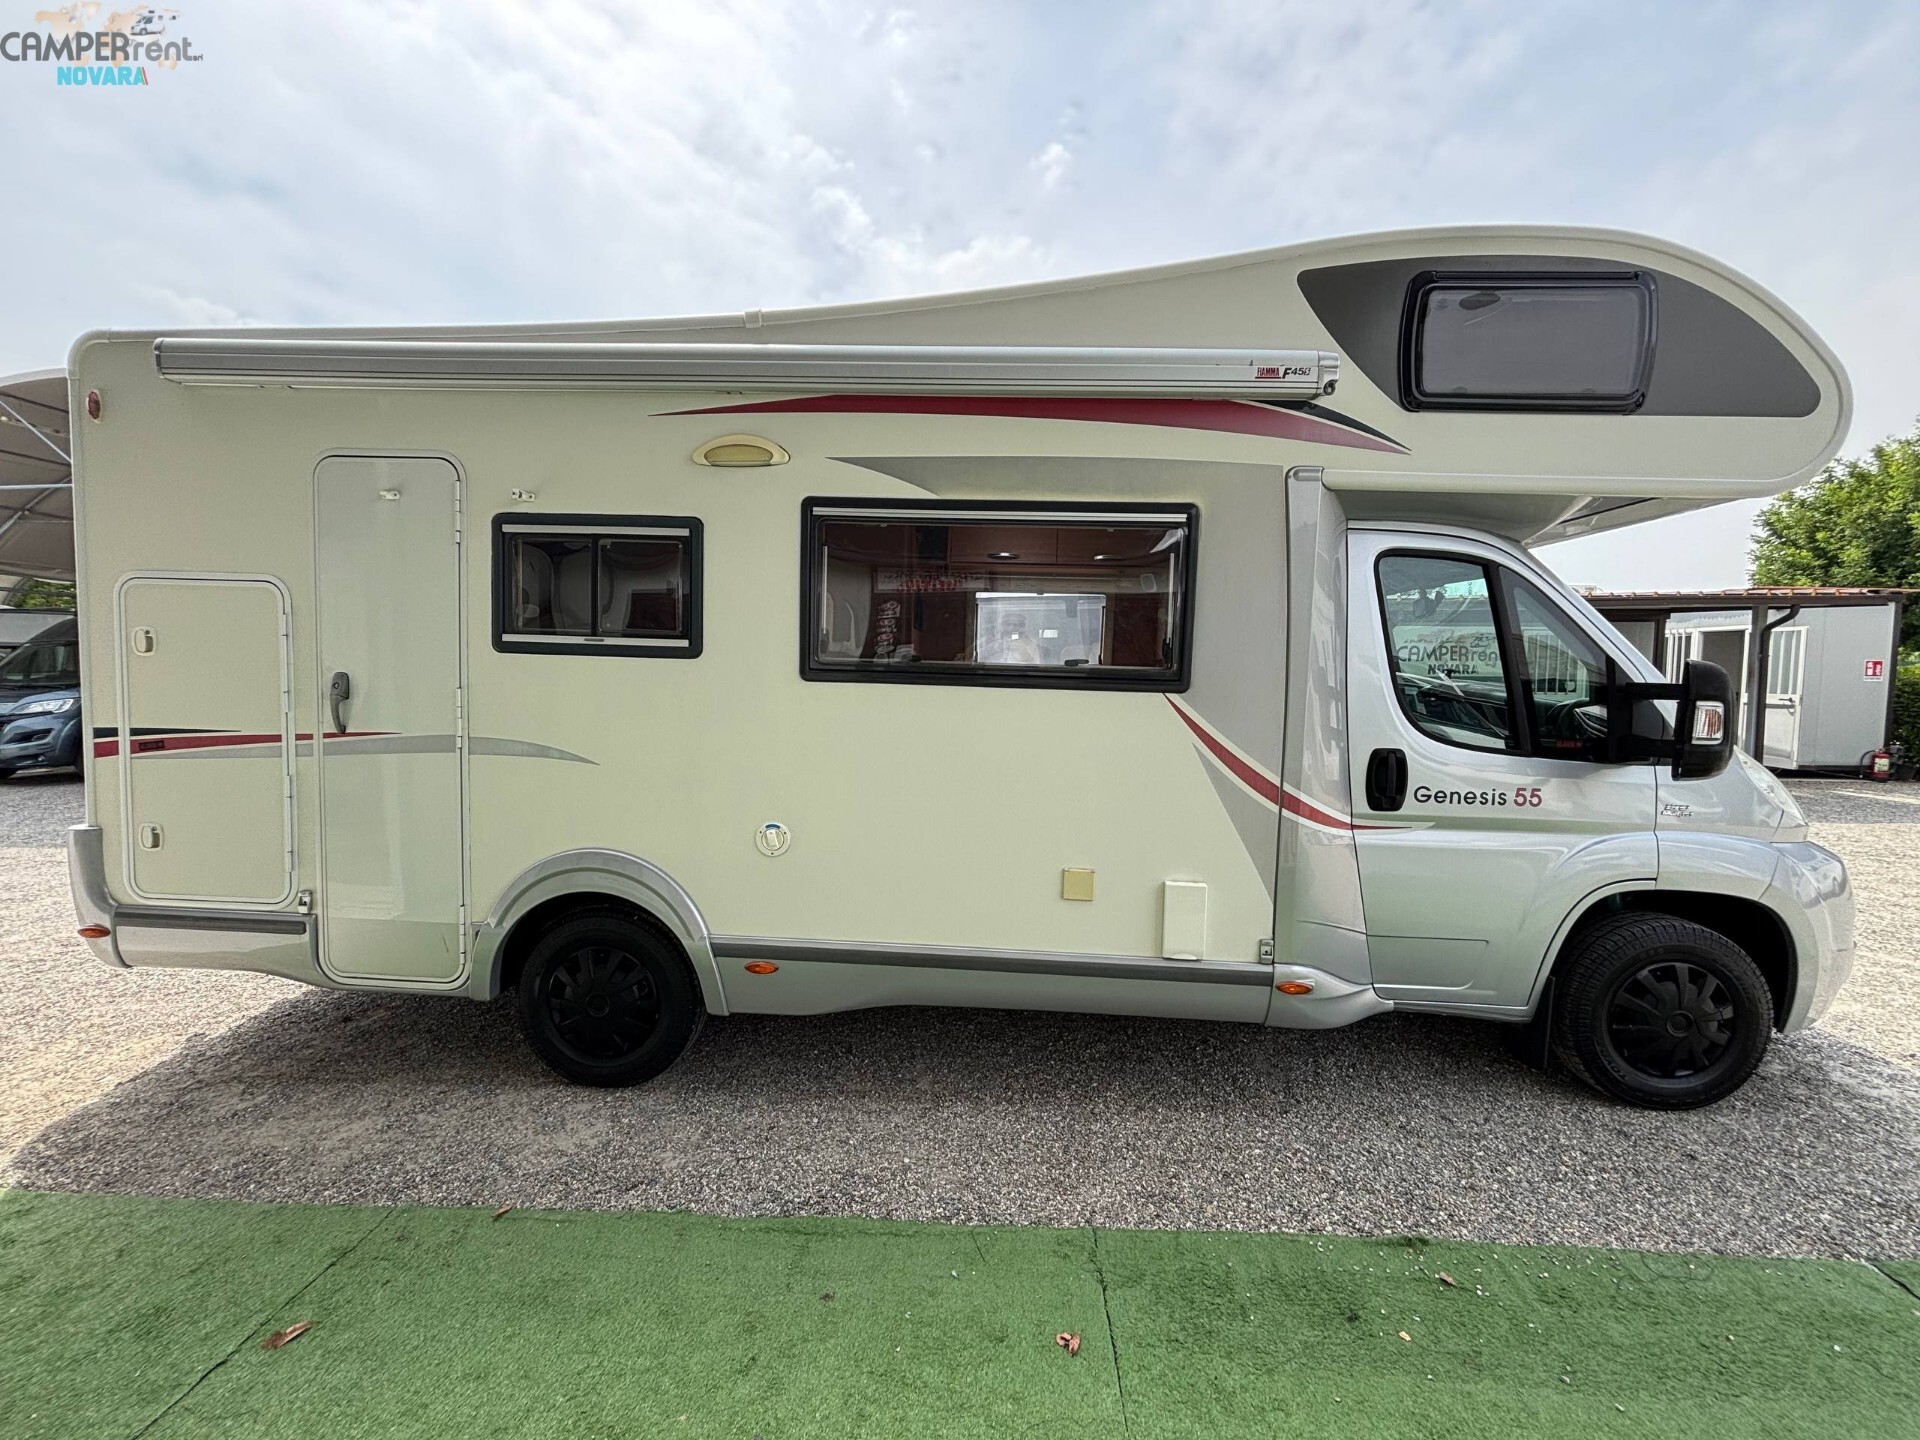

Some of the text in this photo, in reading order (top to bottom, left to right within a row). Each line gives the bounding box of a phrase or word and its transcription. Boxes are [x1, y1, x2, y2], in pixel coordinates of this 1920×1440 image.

[1256, 367, 1280, 377] FIAMMA
[1397, 645, 1498, 662] CAMPERren
[1413, 785, 1543, 808] Genesis 55
